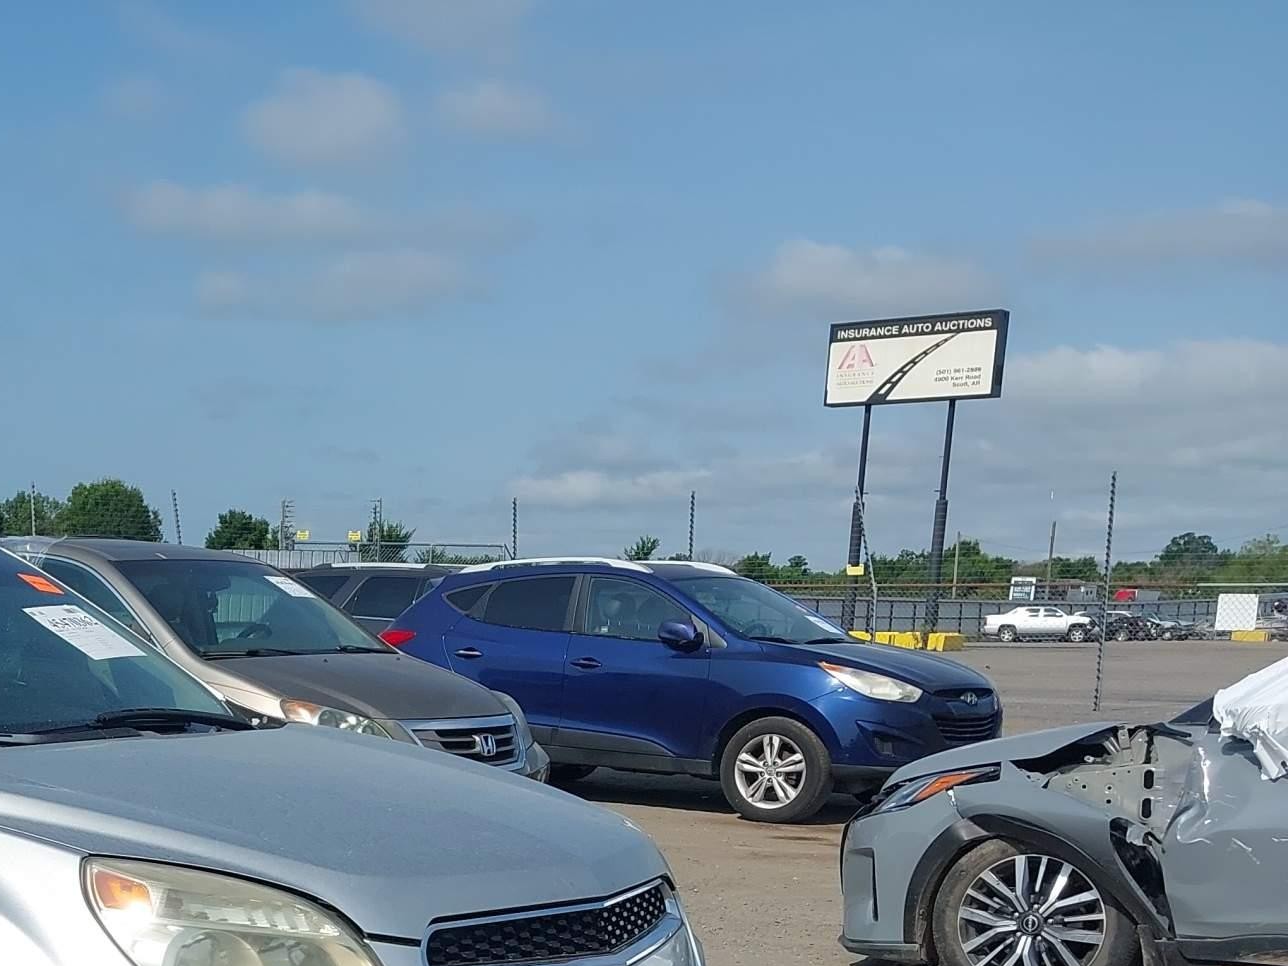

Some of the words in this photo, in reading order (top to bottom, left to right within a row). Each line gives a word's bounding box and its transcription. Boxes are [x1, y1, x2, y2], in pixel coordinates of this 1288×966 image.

[837, 325, 900, 340] INSURANCE
[901, 322, 932, 334] AUTO
[934, 317, 993, 332] AUCTIONS
